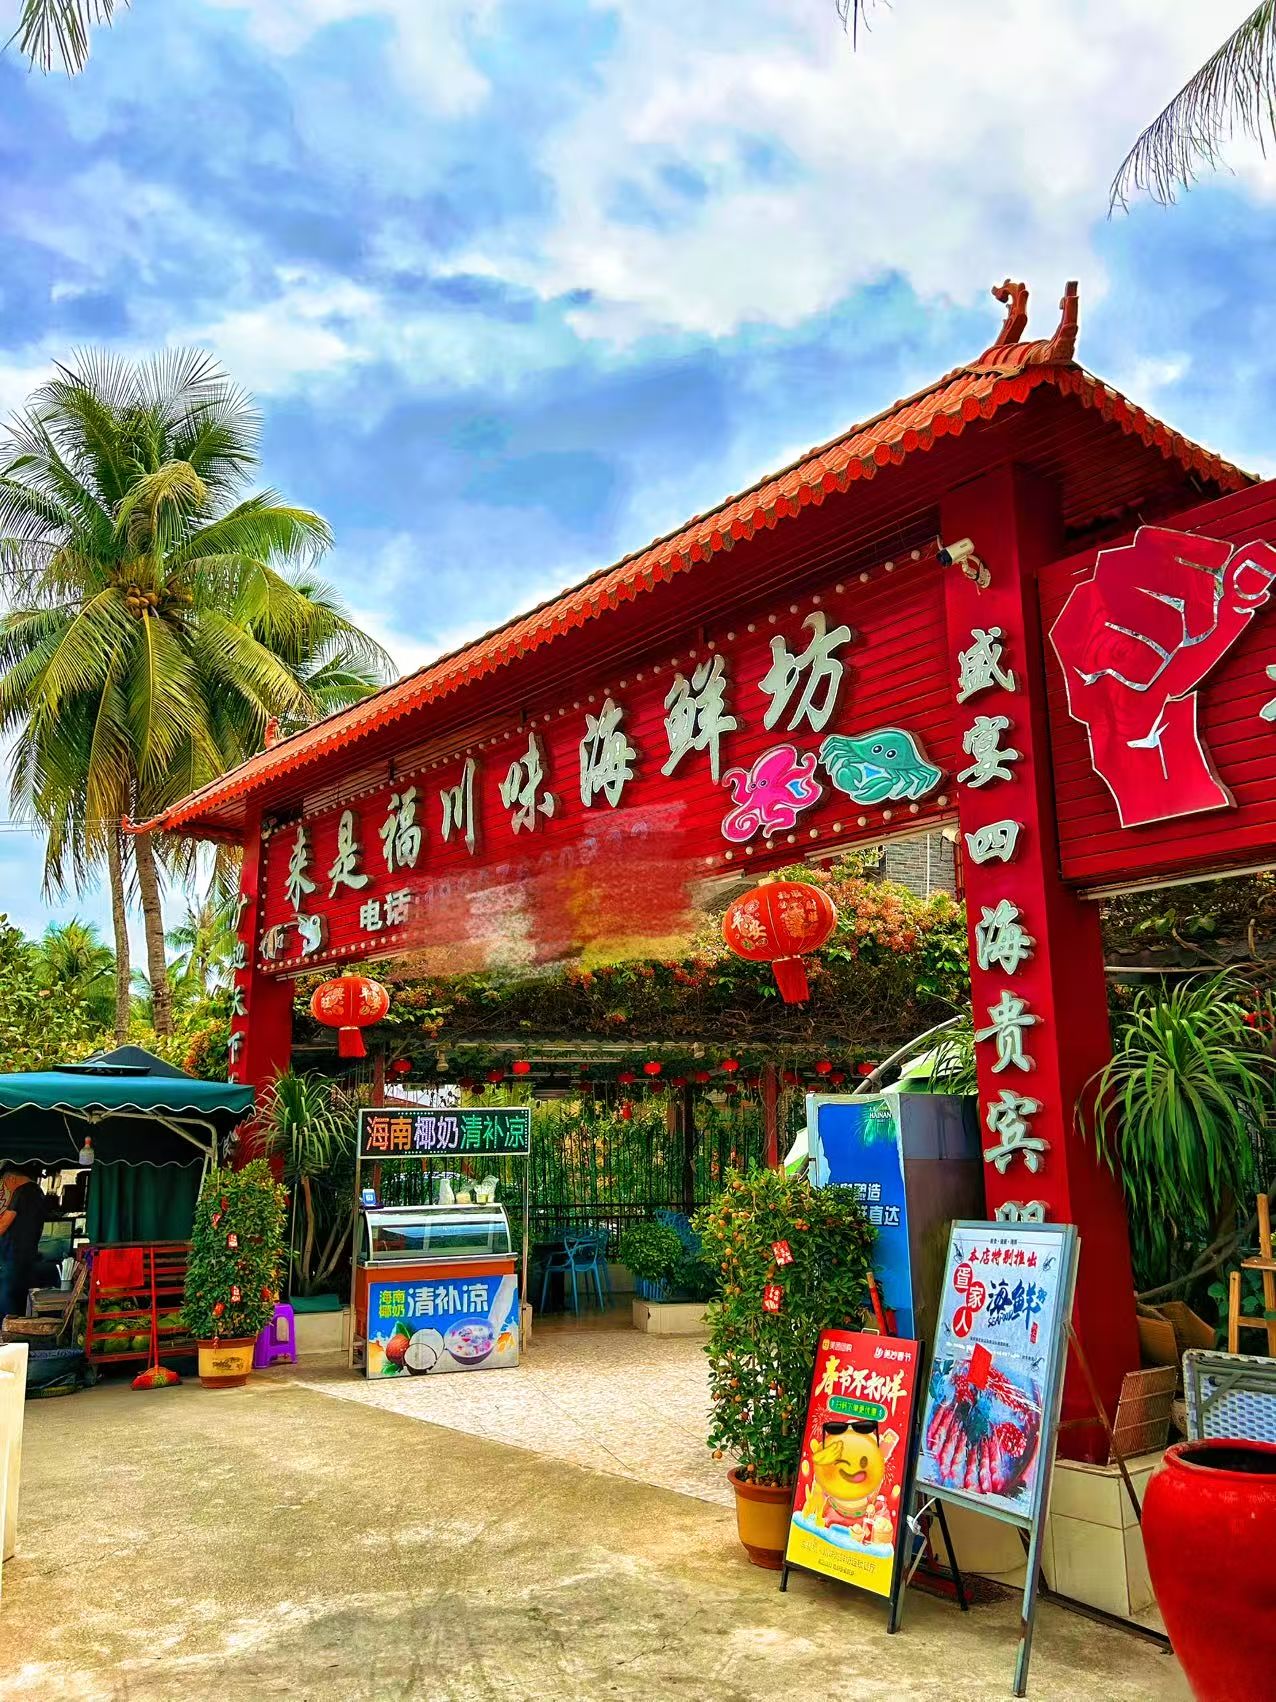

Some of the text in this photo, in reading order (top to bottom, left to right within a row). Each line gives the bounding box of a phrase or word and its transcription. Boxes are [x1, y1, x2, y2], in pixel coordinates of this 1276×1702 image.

[284, 611, 851, 912] 来是福川味海鲜坊
[956, 627, 1046, 1222] 盛宴四海贵宾
[869, 1111, 892, 1119] HAINAN
[366, 1115, 526, 1151] 海南椰奶清补凉
[968, 1247, 1038, 1268] 本店特别推出
[378, 1304, 406, 1318] 椰奶
[379, 1290, 406, 1304] 海南
[407, 1283, 489, 1318] 清补凉
[815, 1354, 908, 1417] 春节不打烊
